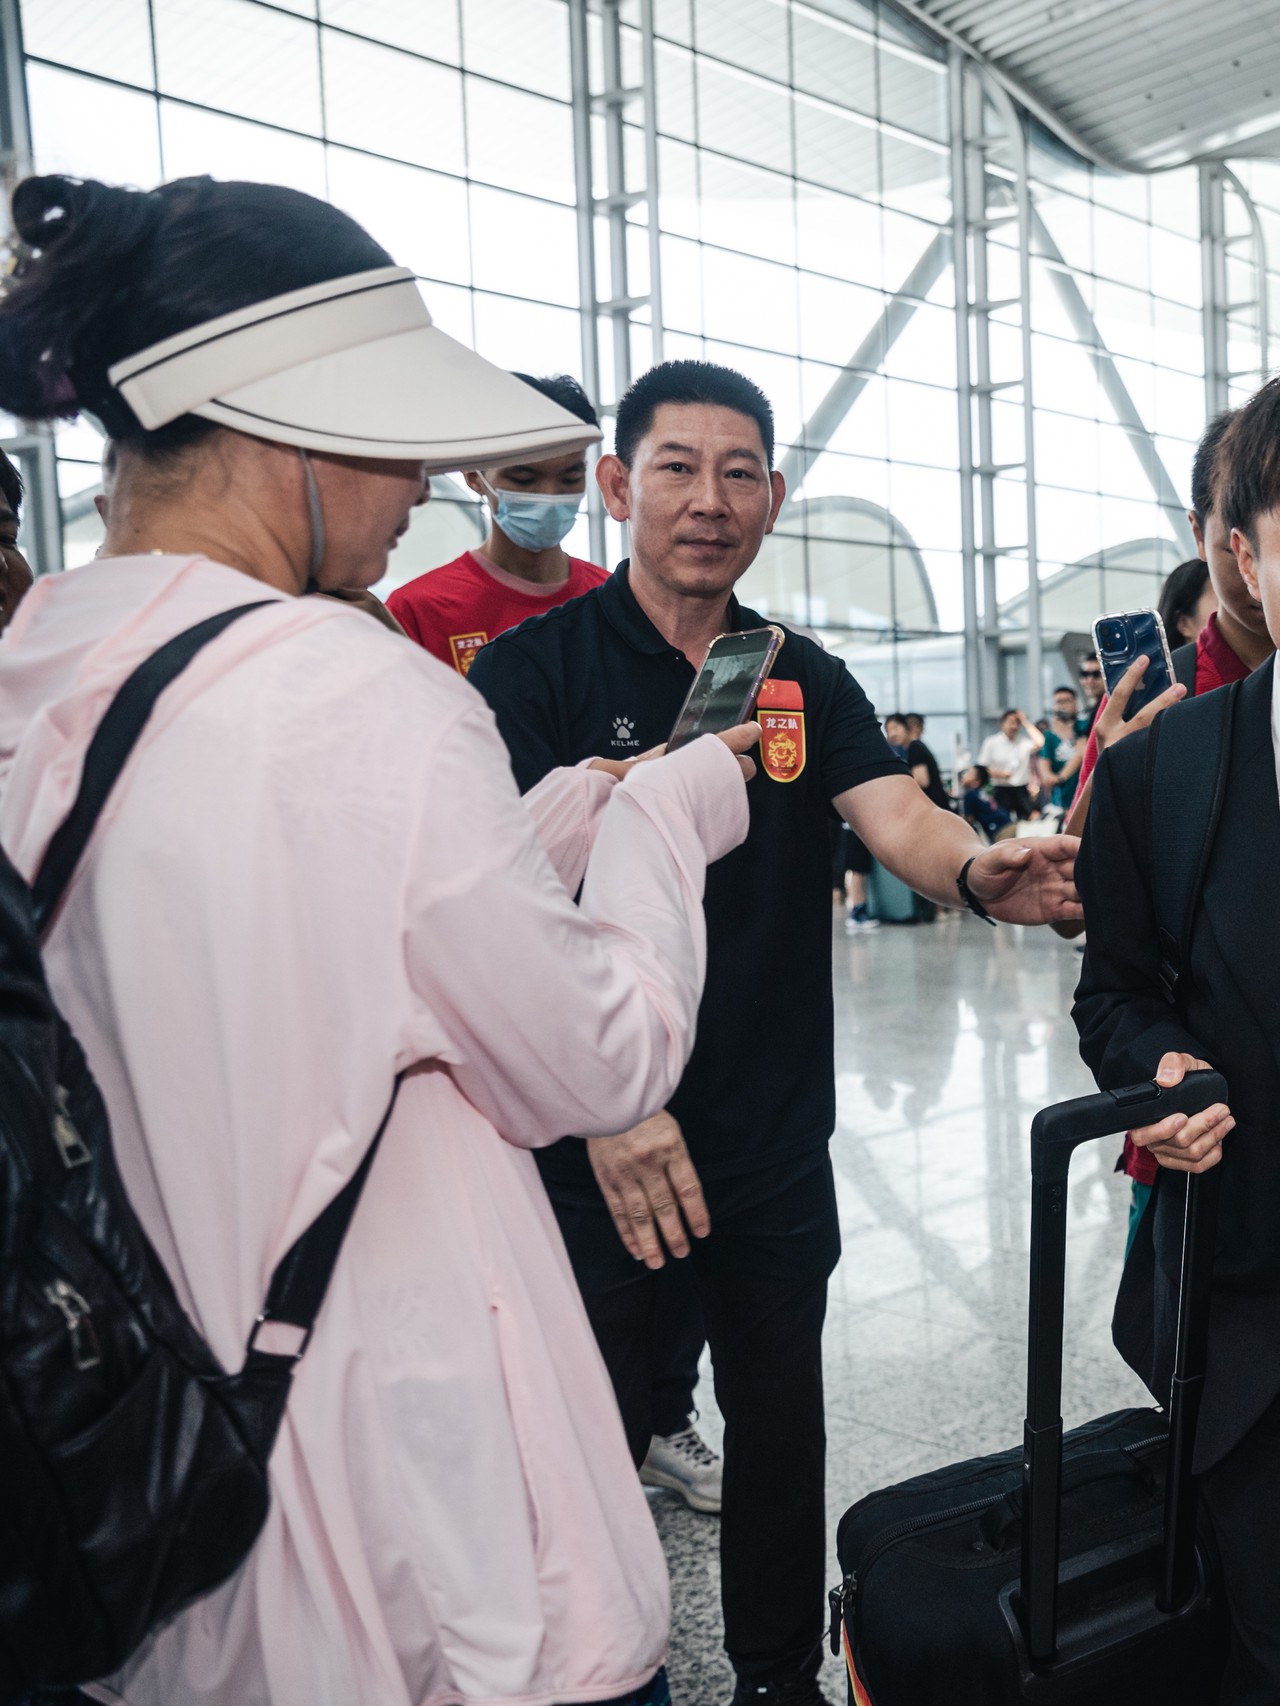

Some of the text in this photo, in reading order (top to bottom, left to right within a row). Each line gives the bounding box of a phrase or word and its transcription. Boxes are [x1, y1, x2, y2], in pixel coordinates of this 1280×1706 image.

[766, 717, 799, 730] 龙之队
[610, 739, 640, 747] KELME
